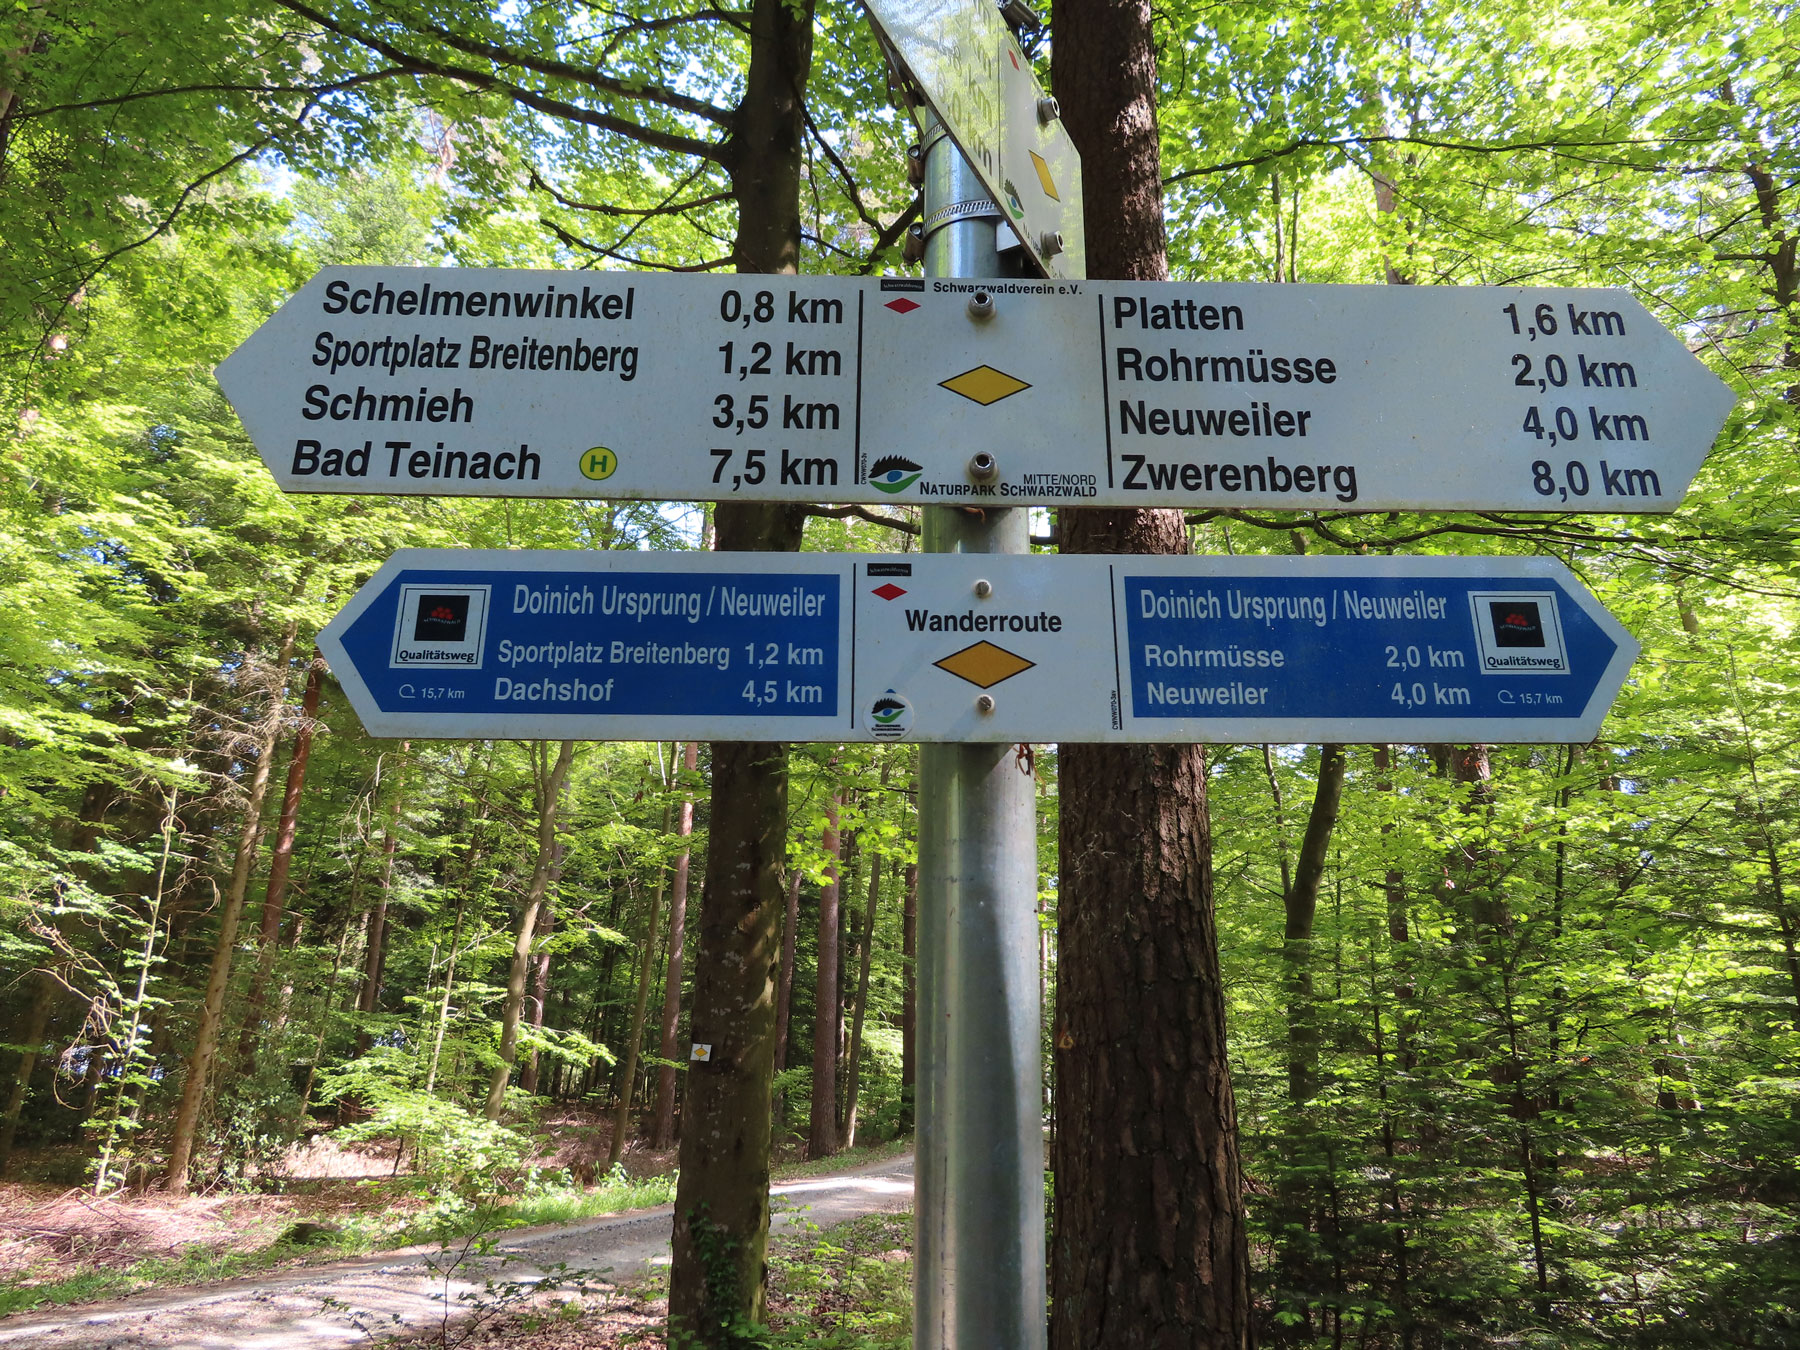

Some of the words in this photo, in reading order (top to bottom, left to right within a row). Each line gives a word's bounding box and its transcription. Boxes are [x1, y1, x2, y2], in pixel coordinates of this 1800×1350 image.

[968, 111, 992, 177] km
[322, 280, 635, 320] Schelmenwinkel
[720, 289, 775, 330] 0,8
[788, 291, 843, 323] km
[1058, 284, 1082, 295] e.V.
[1113, 296, 1244, 330] Platten
[1503, 303, 1558, 342] 1,6
[1567, 303, 1626, 336] km
[312, 332, 461, 376] Sportplatz
[469, 335, 639, 381] Breitenberg
[718, 341, 772, 382] 1,2
[785, 342, 842, 376] km
[1116, 347, 1337, 384] Rohrmüsse
[1511, 354, 1568, 394] 2,0
[1577, 354, 1637, 387] km
[302, 385, 474, 423] Schmieh
[712, 394, 769, 436] 3,5
[783, 395, 840, 430] km
[1119, 400, 1311, 437] Neuweiler
[1522, 406, 1578, 448] 4,0
[1588, 406, 1649, 441] km
[291, 440, 372, 477] Bad
[384, 441, 541, 480] Teinach
[590, 455, 607, 472] H
[710, 449, 766, 491] 7,5
[780, 449, 838, 486] km
[1023, 474, 1096, 486] MITTE/NORD
[1121, 454, 1358, 503] Zwerenberg
[1531, 460, 1590, 503] 8,0
[1600, 460, 1662, 496] km
[919, 482, 996, 496] NATURPARK
[1000, 483, 1097, 497] SCHWARZWALD
[512, 584, 594, 617] Doinich
[602, 586, 701, 623] Ursprung
[705, 586, 716, 617] /
[720, 587, 825, 618] Neuweiler
[1141, 589, 1221, 620] Doinich
[1228, 590, 1327, 626] Ursprung
[1345, 590, 1447, 620] Neuweiler
[905, 609, 1062, 632] Wanderroute
[399, 650, 475, 662] Qualitätsweg
[498, 639, 603, 668] Sportplatz
[609, 640, 730, 671] Breitenberg
[744, 642, 779, 668] 1,2
[787, 642, 824, 666] km
[1145, 644, 1285, 669] Rohrmüsse
[1385, 647, 1422, 672] 2,0
[1428, 646, 1465, 668] km
[1487, 656, 1561, 669] Qualitätsweg
[421, 688, 445, 699] 15,7
[447, 688, 465, 699] km
[494, 676, 614, 702] Dachshof
[742, 680, 778, 706] 4,5
[786, 680, 823, 704] km
[1147, 682, 1268, 705] Neuweiler
[1391, 683, 1425, 709] 4,0
[1433, 683, 1471, 705] km
[1520, 693, 1542, 705] 15,7
[1545, 693, 1563, 704] km
